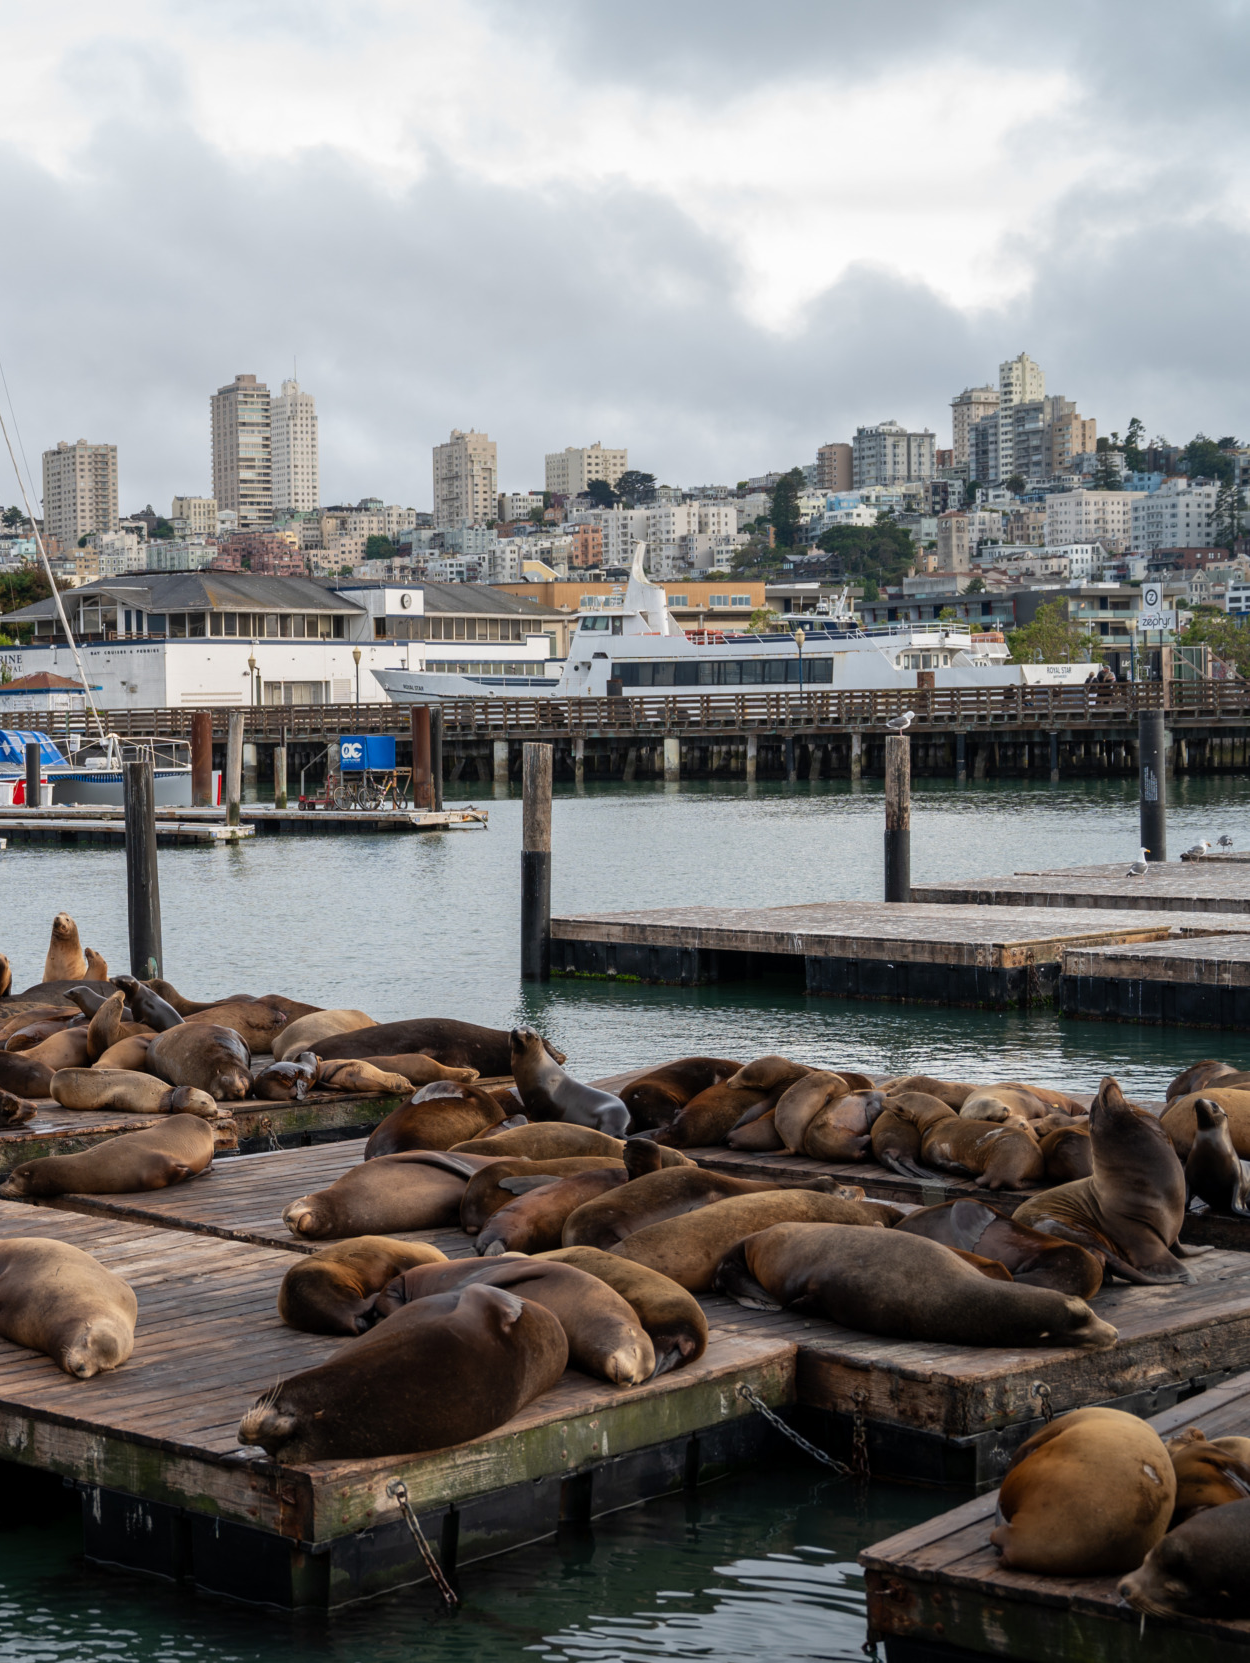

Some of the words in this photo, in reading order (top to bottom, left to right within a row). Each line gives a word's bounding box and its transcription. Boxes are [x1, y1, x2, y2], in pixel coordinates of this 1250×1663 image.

[1142, 612, 1171, 629] zephyr
[1046, 666, 1060, 674] ROYAL
[1061, 666, 1072, 674] STAR
